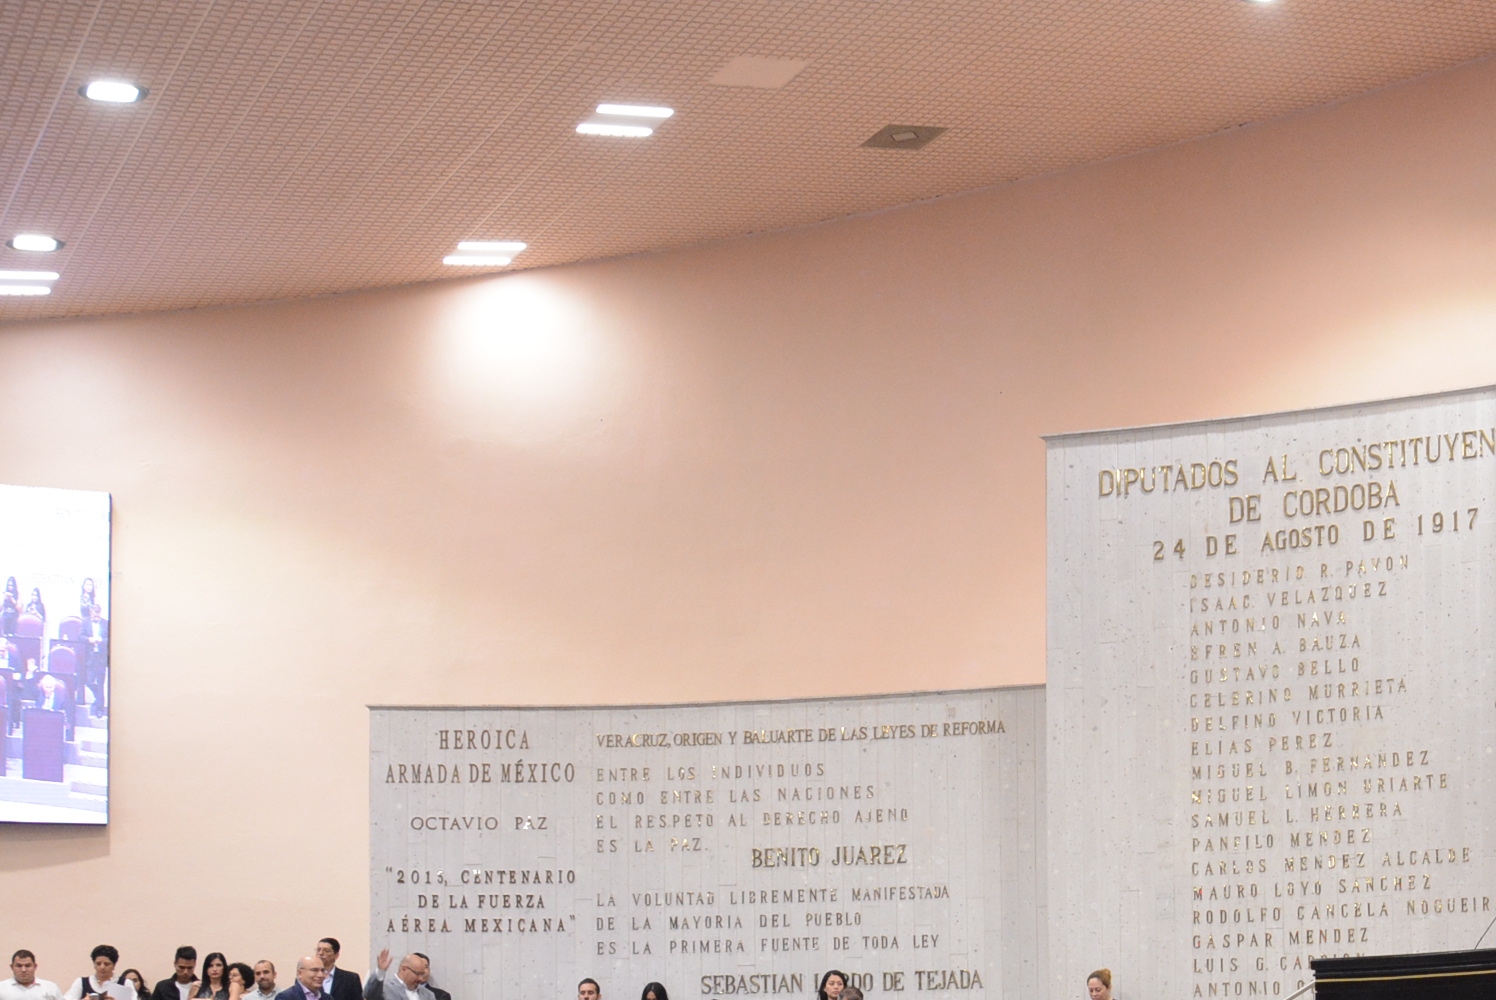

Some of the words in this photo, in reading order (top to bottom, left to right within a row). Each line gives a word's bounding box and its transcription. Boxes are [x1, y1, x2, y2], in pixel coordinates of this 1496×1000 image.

[1099, 459, 1239, 497] DIPUTADOS
[1262, 454, 1297, 483] AL
[1229, 494, 1262, 523] DE
[1283, 479, 1400, 518] CORDOBA
[1153, 538, 1185, 560] 24
[1206, 534, 1237, 557] DE
[1261, 524, 1339, 552] AGOSTO
[1363, 517, 1396, 541] DE
[1417, 508, 1479, 535] 1917
[1190, 565, 1305, 588] DESIDERIO
[1320, 563, 1333, 578] R.
[1345, 554, 1408, 577] PAVON
[1267, 581, 1387, 606] VELAZQUEZ
[1190, 615, 1279, 637] ANTONIO
[1297, 611, 1347, 629] NAVA
[1190, 641, 1257, 661] EFREN
[1272, 640, 1285, 654] A.
[1299, 634, 1360, 652] BAUZA
[1190, 665, 1280, 684] GUSTAVO
[1298, 657, 1359, 676] BELLO
[1190, 687, 1292, 708] CELERINO
[1309, 678, 1407, 700] MURRIETA
[1191, 713, 1276, 732] DELFINO
[1292, 705, 1384, 726] VICTORIA
[439, 730, 530, 749] HEROICA
[597, 733, 671, 748] VERACRUZ,
[674, 732, 722, 745] ORIGEN
[728, 731, 737, 745] Y
[743, 728, 813, 744] BALUARTE
[818, 728, 836, 741] DE
[841, 726, 868, 740] LAS
[873, 724, 916, 740] LEYES
[921, 723, 938, 738] DE
[943, 720, 1006, 736] REFORMA
[1191, 737, 1253, 756] ELIAS
[1269, 732, 1333, 752] PEREZ
[385, 764, 461, 783] ARMADA
[469, 763, 492, 783] DE
[501, 759, 575, 783] MÉXICO
[596, 768, 651, 782] ENTRE
[667, 767, 695, 781] LOS
[711, 763, 825, 779] INDIVIDUOS
[1191, 762, 1267, 780] MIGUEL
[1310, 750, 1429, 774] FERNANDEZ
[596, 791, 645, 805] COMO
[660, 790, 714, 804] ENTRE
[730, 788, 761, 803] LAS
[778, 785, 875, 801] NACIONES
[1191, 785, 1267, 805] MIGUEL
[1285, 780, 1347, 799] LIMON
[1363, 773, 1448, 794] URIARTE
[410, 816, 498, 830] OCTAVIO
[515, 816, 548, 830] PAZ
[596, 815, 617, 829] EL
[635, 813, 714, 828] RESPETO
[728, 813, 747, 827] AL
[762, 810, 840, 825] DERECHO
[854, 808, 909, 823] AJENO
[1191, 809, 1270, 828] SAMUEL
[1310, 802, 1402, 822] HERRERA
[596, 839, 617, 853] ES
[635, 839, 654, 853] LA
[1191, 833, 1274, 852] PANFILO
[1290, 828, 1371, 848] MENDEZ
[752, 847, 820, 868] BENITO
[832, 844, 908, 866] JUAREZ
[1191, 858, 1267, 876] CARLOS
[1284, 852, 1366, 872] MENDEZ
[1382, 847, 1471, 867] ALCALDE
[461, 869, 576, 884] CENTENARIO
[1193, 883, 1258, 901] MAURO
[1274, 880, 1322, 898] LOYO
[1338, 874, 1431, 894] SANCHEZ
[418, 894, 439, 908] DE
[449, 894, 468, 908] LA
[478, 894, 545, 908] FUERZA
[596, 893, 616, 907] LA
[632, 891, 715, 906] VOLUNTAD
[730, 888, 838, 904] LIBREMENTE
[852, 885, 950, 901] MANIFESTADA
[387, 914, 451, 932] AÉREA
[596, 917, 615, 931] DE
[631, 917, 652, 930] LA
[669, 915, 743, 930] MAYORIA
[759, 913, 790, 928] DEL
[805, 912, 862, 927] PUEBLO
[1193, 907, 1281, 925] RODOLFO
[1297, 901, 1389, 921] CANCELA
[597, 941, 617, 955] ES
[632, 941, 652, 955] LA
[669, 939, 745, 954] PRIMERA
[761, 937, 819, 951] FUENTE
[833, 936, 850, 950] DE
[862, 935, 899, 949] TODA
[913, 934, 939, 949] LEY
[1193, 931, 1273, 949] GASPAR
[1289, 927, 1369, 945] MENDEZ
[1193, 956, 1238, 974] LUIS
[701, 973, 802, 995] SEBASTIAN
[883, 971, 904, 991] DE
[915, 969, 983, 990] TEJADA
[1193, 981, 1281, 998] ANTONIO
